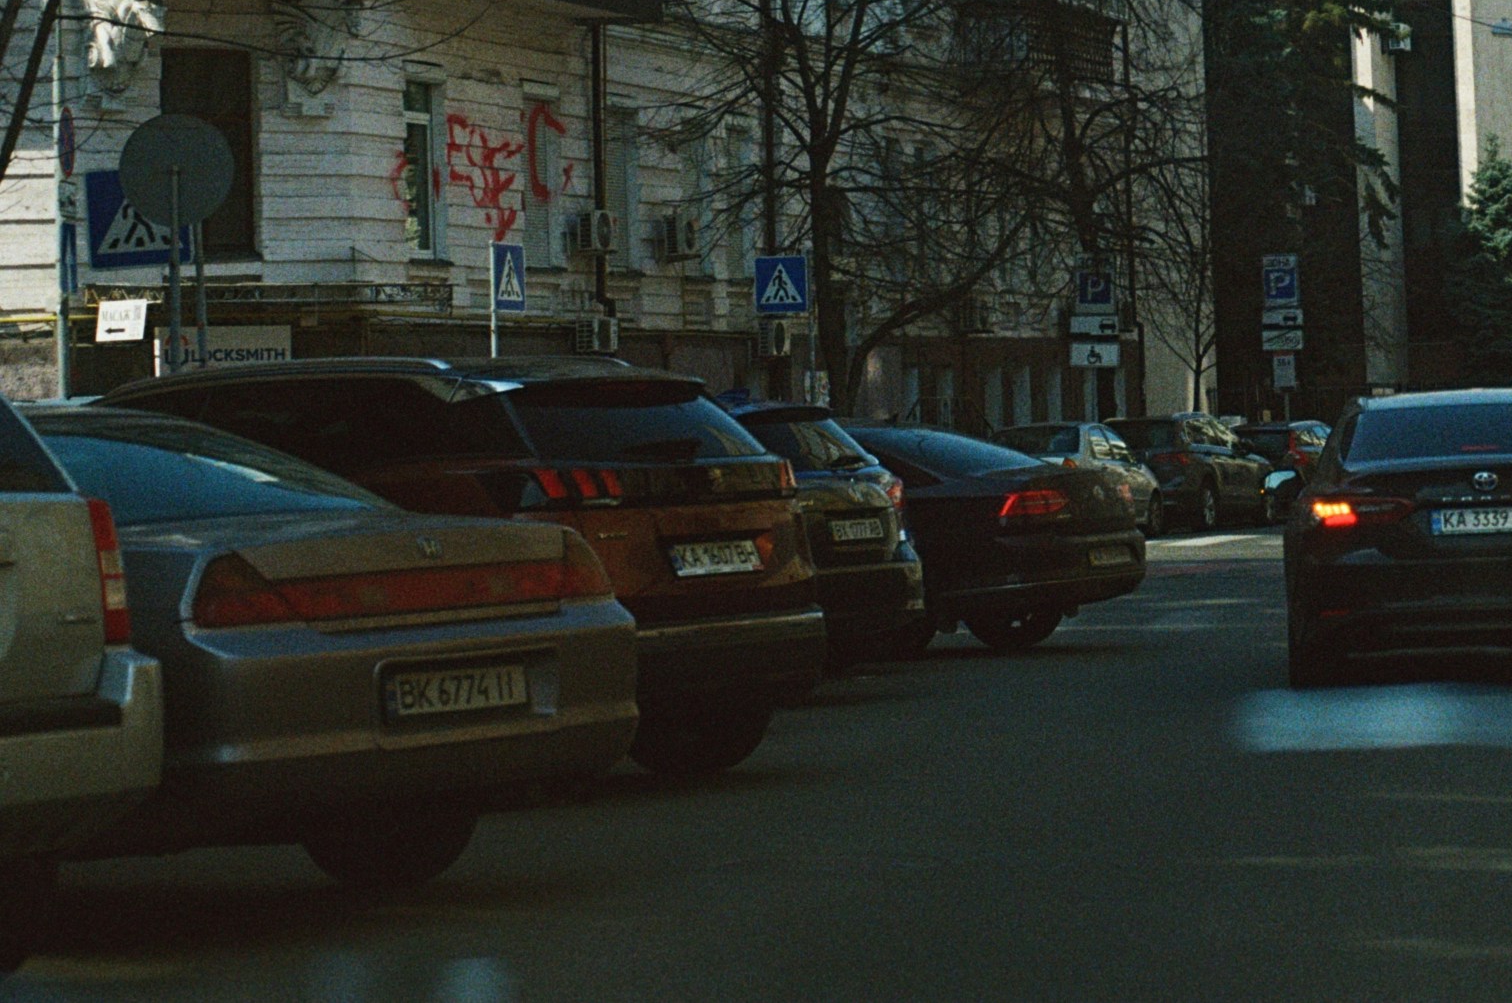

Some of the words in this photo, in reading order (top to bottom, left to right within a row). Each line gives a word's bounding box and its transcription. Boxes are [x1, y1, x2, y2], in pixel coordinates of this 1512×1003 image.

[1442, 510, 1468, 529] KA
[1471, 508, 1510, 527] 3339
[676, 545, 704, 568] KA
[399, 677, 435, 709] BK
[437, 673, 490, 706] 6774
